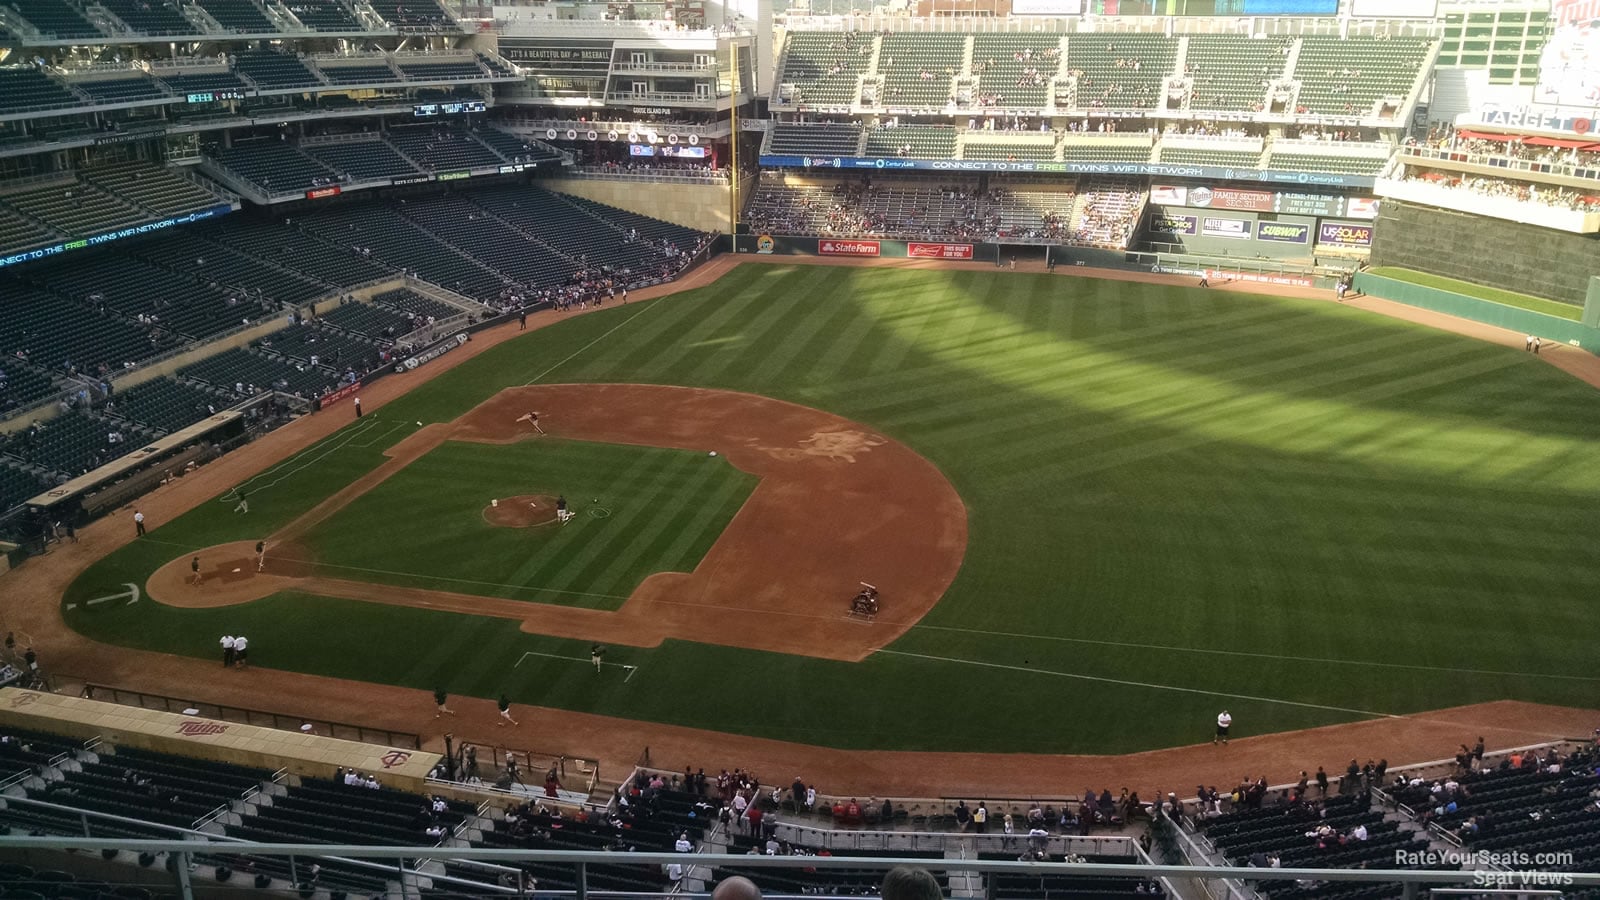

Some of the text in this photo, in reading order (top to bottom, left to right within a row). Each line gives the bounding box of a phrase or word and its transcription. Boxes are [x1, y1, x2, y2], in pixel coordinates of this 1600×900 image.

[581, 51, 610, 60] BASEBALL
[1478, 107, 1569, 131] TARGET
[932, 161, 1203, 176] CONNECT TO THE FREE TWINS WIFI NETWORK
[1309, 176, 1344, 184] CenturyLink
[1214, 190, 1271, 202] FAMILY SECTION
[1225, 199, 1256, 209] SEC. 311
[1260, 225, 1307, 238] SUBWAY
[30, 250, 43, 258] TO
[44, 245, 63, 255] THE
[65, 239, 88, 250] FREE
[89, 232, 117, 244] TWINS
[117, 228, 136, 238] WIFI
[136, 219, 175, 234] NETWORK
[175, 720, 230, 736] Twins
